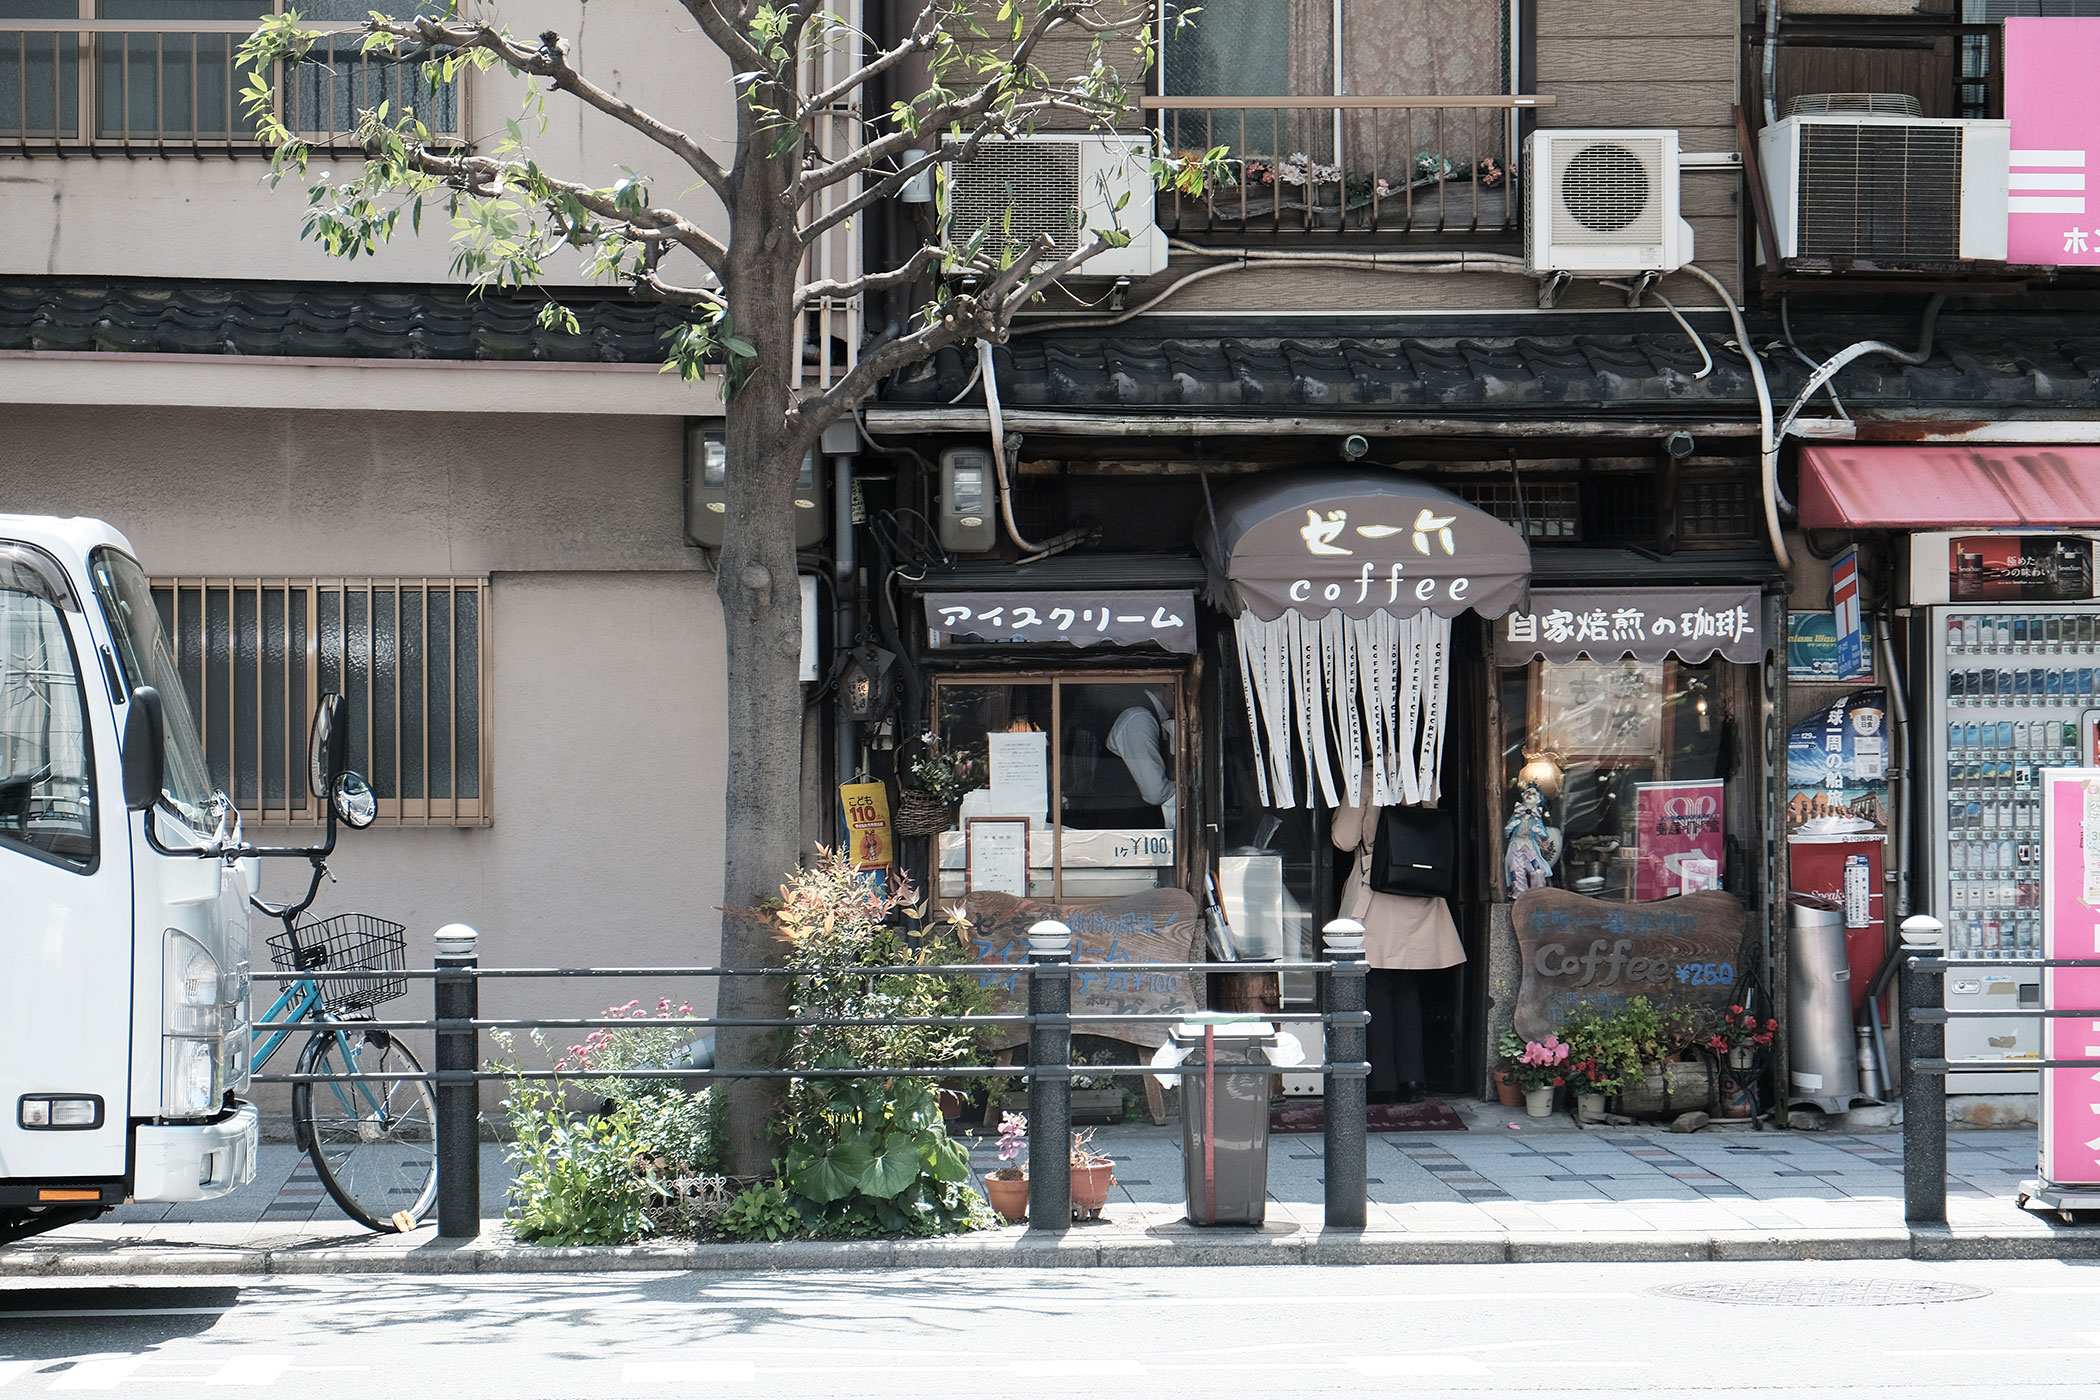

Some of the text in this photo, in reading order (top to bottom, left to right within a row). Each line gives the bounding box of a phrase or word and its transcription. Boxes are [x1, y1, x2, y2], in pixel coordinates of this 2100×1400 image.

[2063, 227, 2100, 254] ホ
[1289, 562, 1469, 604] coffee
[938, 606, 1185, 631] アイスクリーム
[1507, 605, 1754, 643] 自家焙煎の珈琲
[1825, 696, 1849, 806] 地球一周の船旅
[849, 795, 873, 807] こども
[849, 805, 876, 822] 110
[1534, 938, 1734, 988] Coffee ¥250
